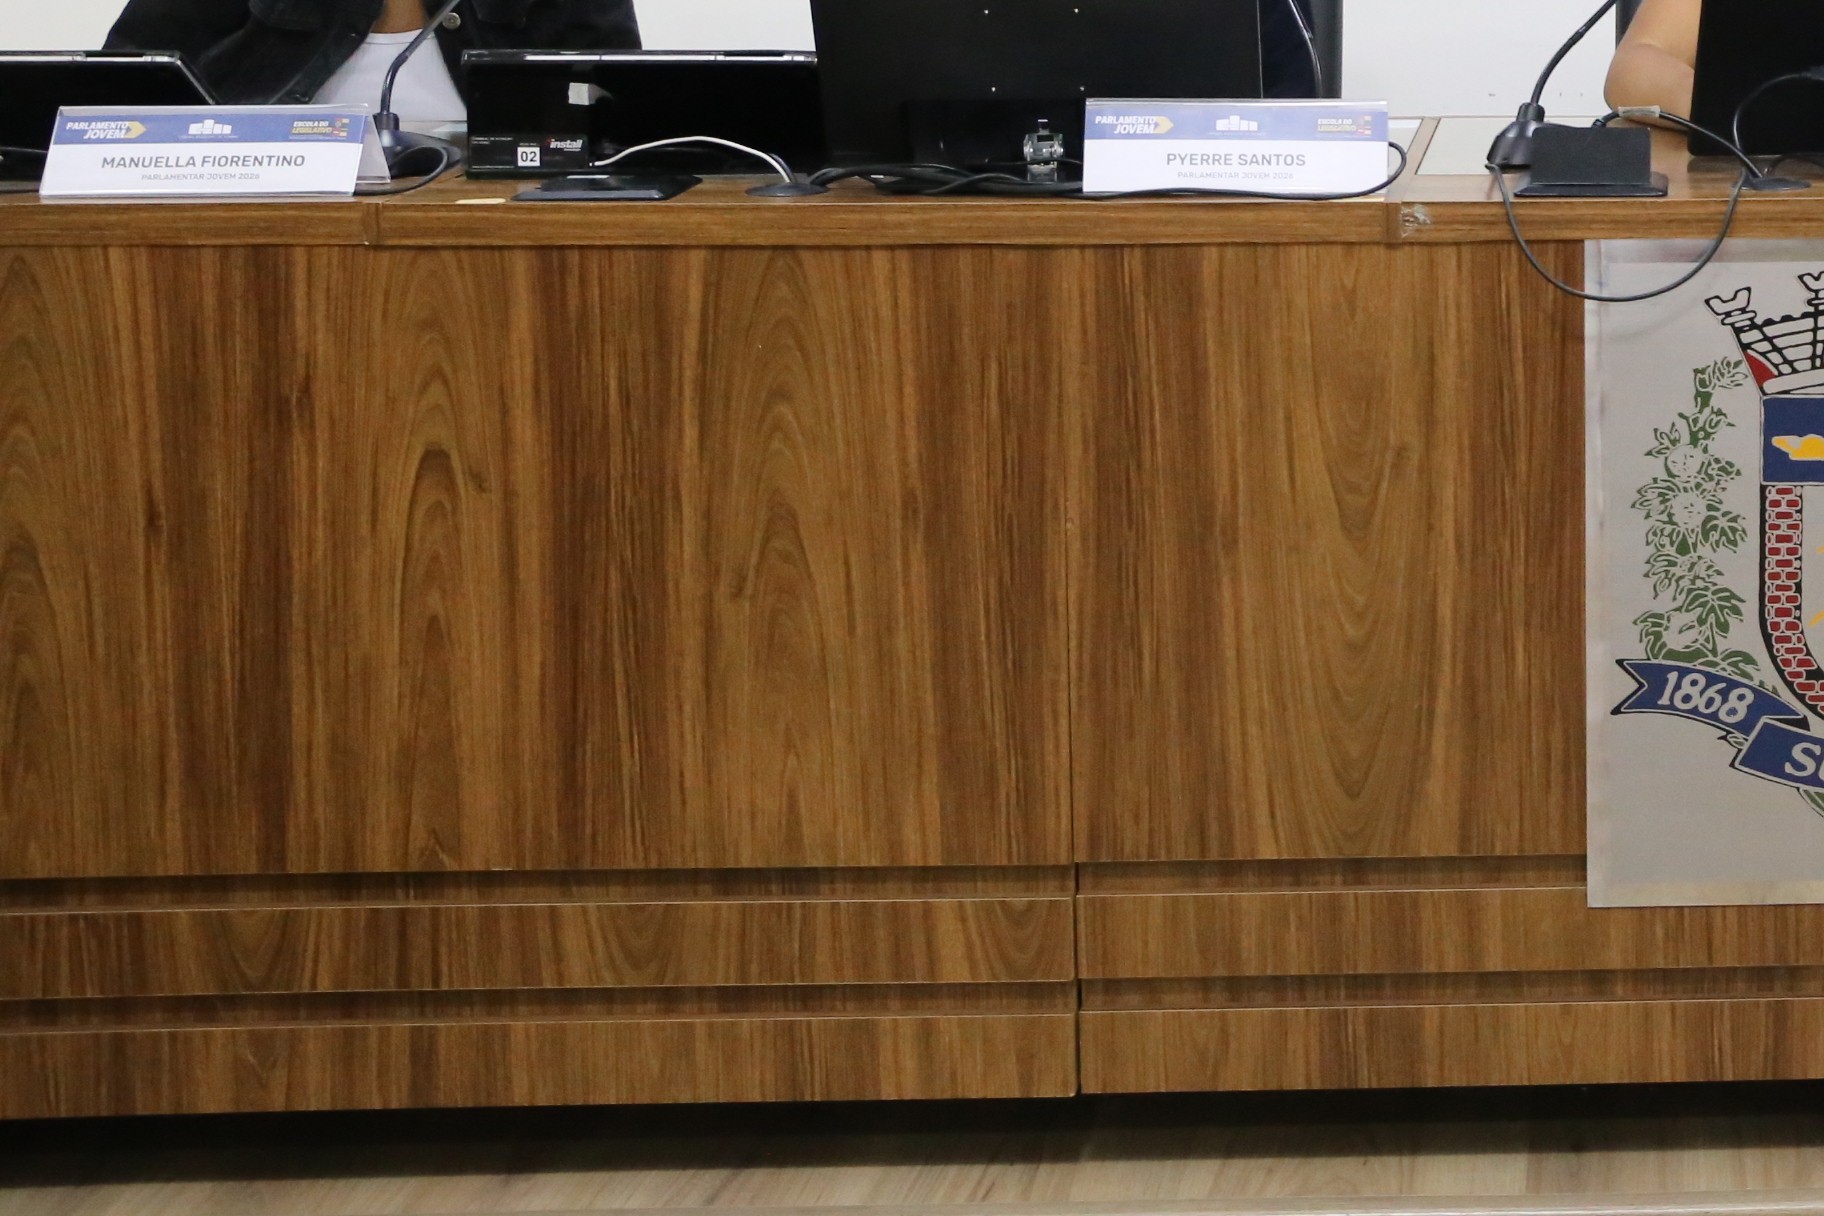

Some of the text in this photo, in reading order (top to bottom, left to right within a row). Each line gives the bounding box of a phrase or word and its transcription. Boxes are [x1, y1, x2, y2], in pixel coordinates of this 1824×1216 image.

[1095, 115, 1157, 124] PARLAMENTO
[66, 121, 129, 130] PARLAMENTO
[1113, 124, 1156, 134] JOVEM
[83, 129, 127, 139] JOVEM
[550, 138, 584, 149] install
[520, 151, 537, 162] 02
[1166, 153, 1306, 166] PYERRE SANTOS
[101, 155, 306, 169] MANUELLA FIORENTINO
[141, 173, 205, 181] PARLAMENTAR
[207, 172, 236, 180] JOVEM
[1657, 670, 1755, 724] 1868
